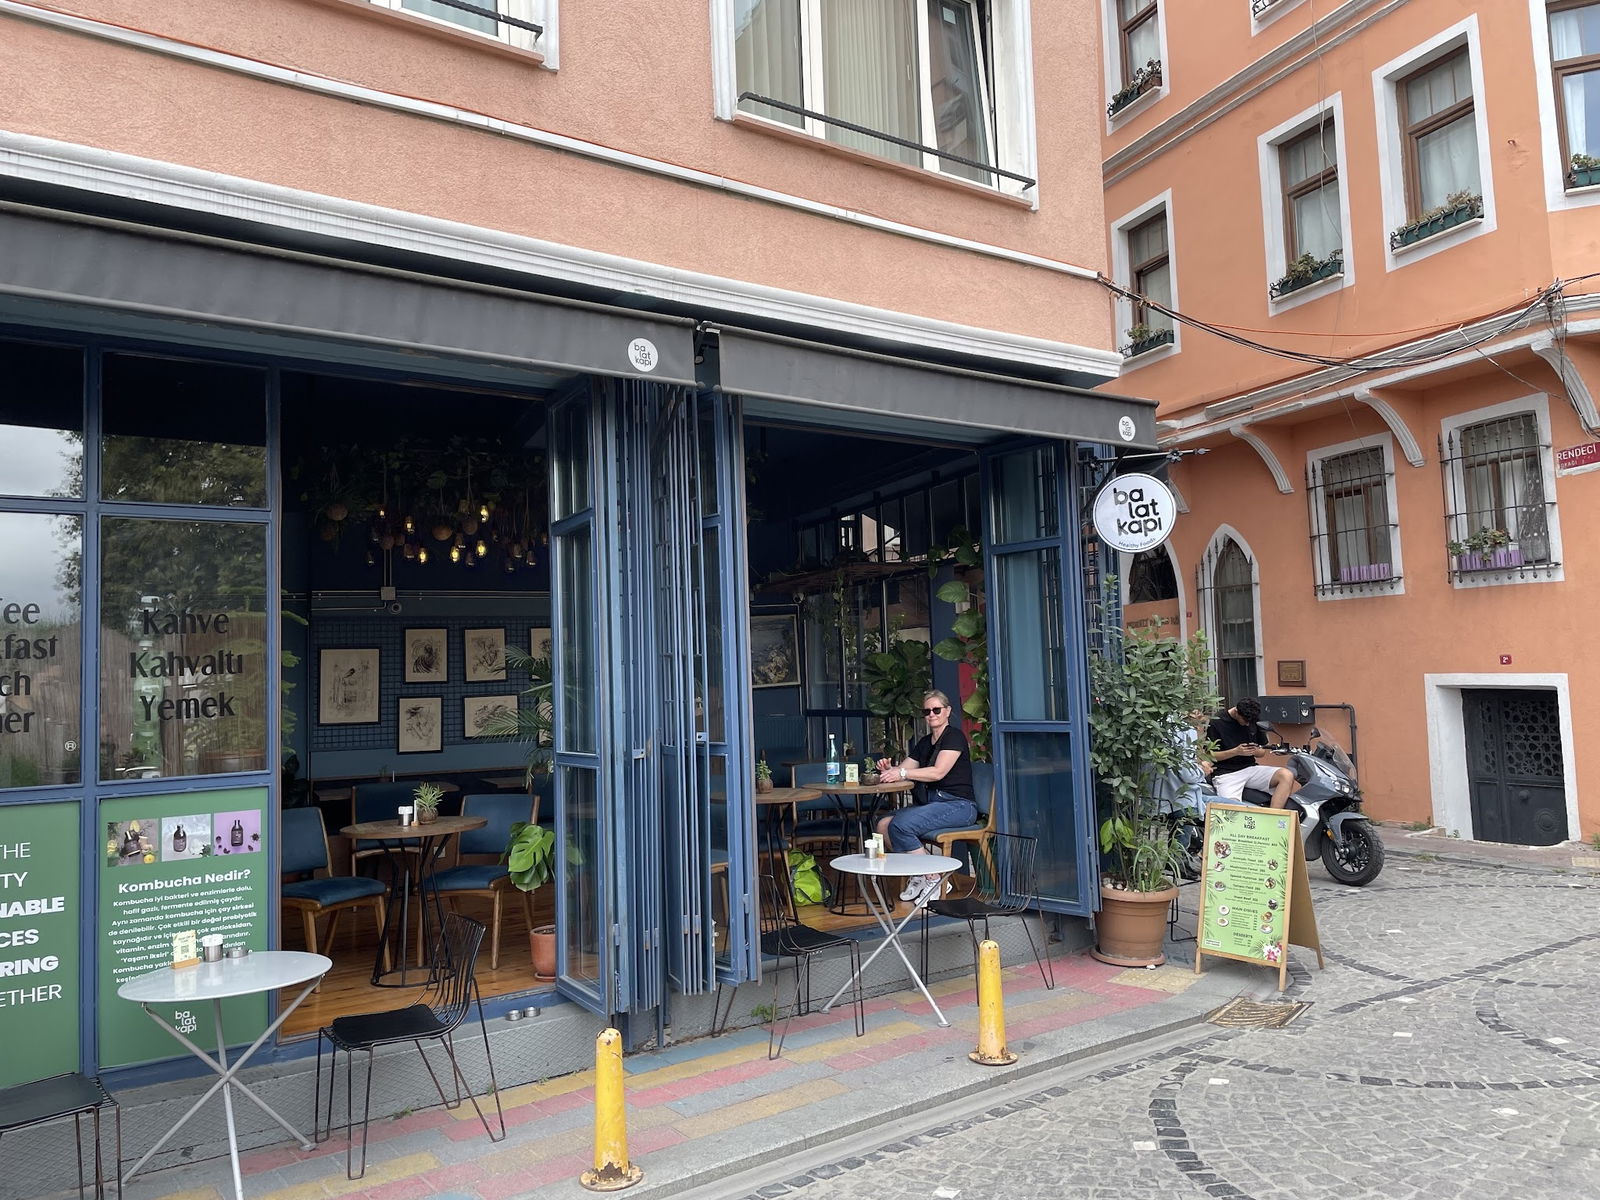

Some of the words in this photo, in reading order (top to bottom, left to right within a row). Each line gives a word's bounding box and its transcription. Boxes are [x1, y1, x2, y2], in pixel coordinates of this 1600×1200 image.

[634, 342, 646, 351] ba
[1113, 487, 1144, 505] ba
[1128, 498, 1160, 519] lat
[0, 597, 41, 624] ee
[143, 608, 230, 635] Kahve
[0, 634, 58, 660] fast
[130, 649, 243, 678] Kahvaltı
[140, 691, 235, 721] Yemek
[0, 711, 35, 734] er
[118, 876, 202, 894] Kombucha
[205, 868, 251, 884] Nedir?
[113, 897, 154, 907] Kombucha
[164, 892, 190, 901] bakteri
[200, 886, 236, 897] enzimlerle
[123, 907, 140, 915] hafif
[161, 902, 193, 911] fermente
[194, 898, 220, 906] edilmiş
[112, 919, 129, 927] Aynı
[129, 915, 164, 924] zamanda
[165, 909, 203, 919] kombucha
[218, 906, 231, 914] çay
[232, 902, 255, 911] sirkesi
[157, 922, 172, 931] Çok
[173, 920, 190, 928] etkili
[201, 916, 221, 924] doğal
[113, 935, 152, 945] kaynağıdır
[196, 927, 209, 935] çok
[210, 922, 253, 932] antioksidan,
[116, 945, 146, 954] vitamin,
[147, 942, 170, 950] enzim
[113, 963, 153, 974] Kombucha
[175, 1011, 190, 1020] ba
[181, 1015, 196, 1026] lat
